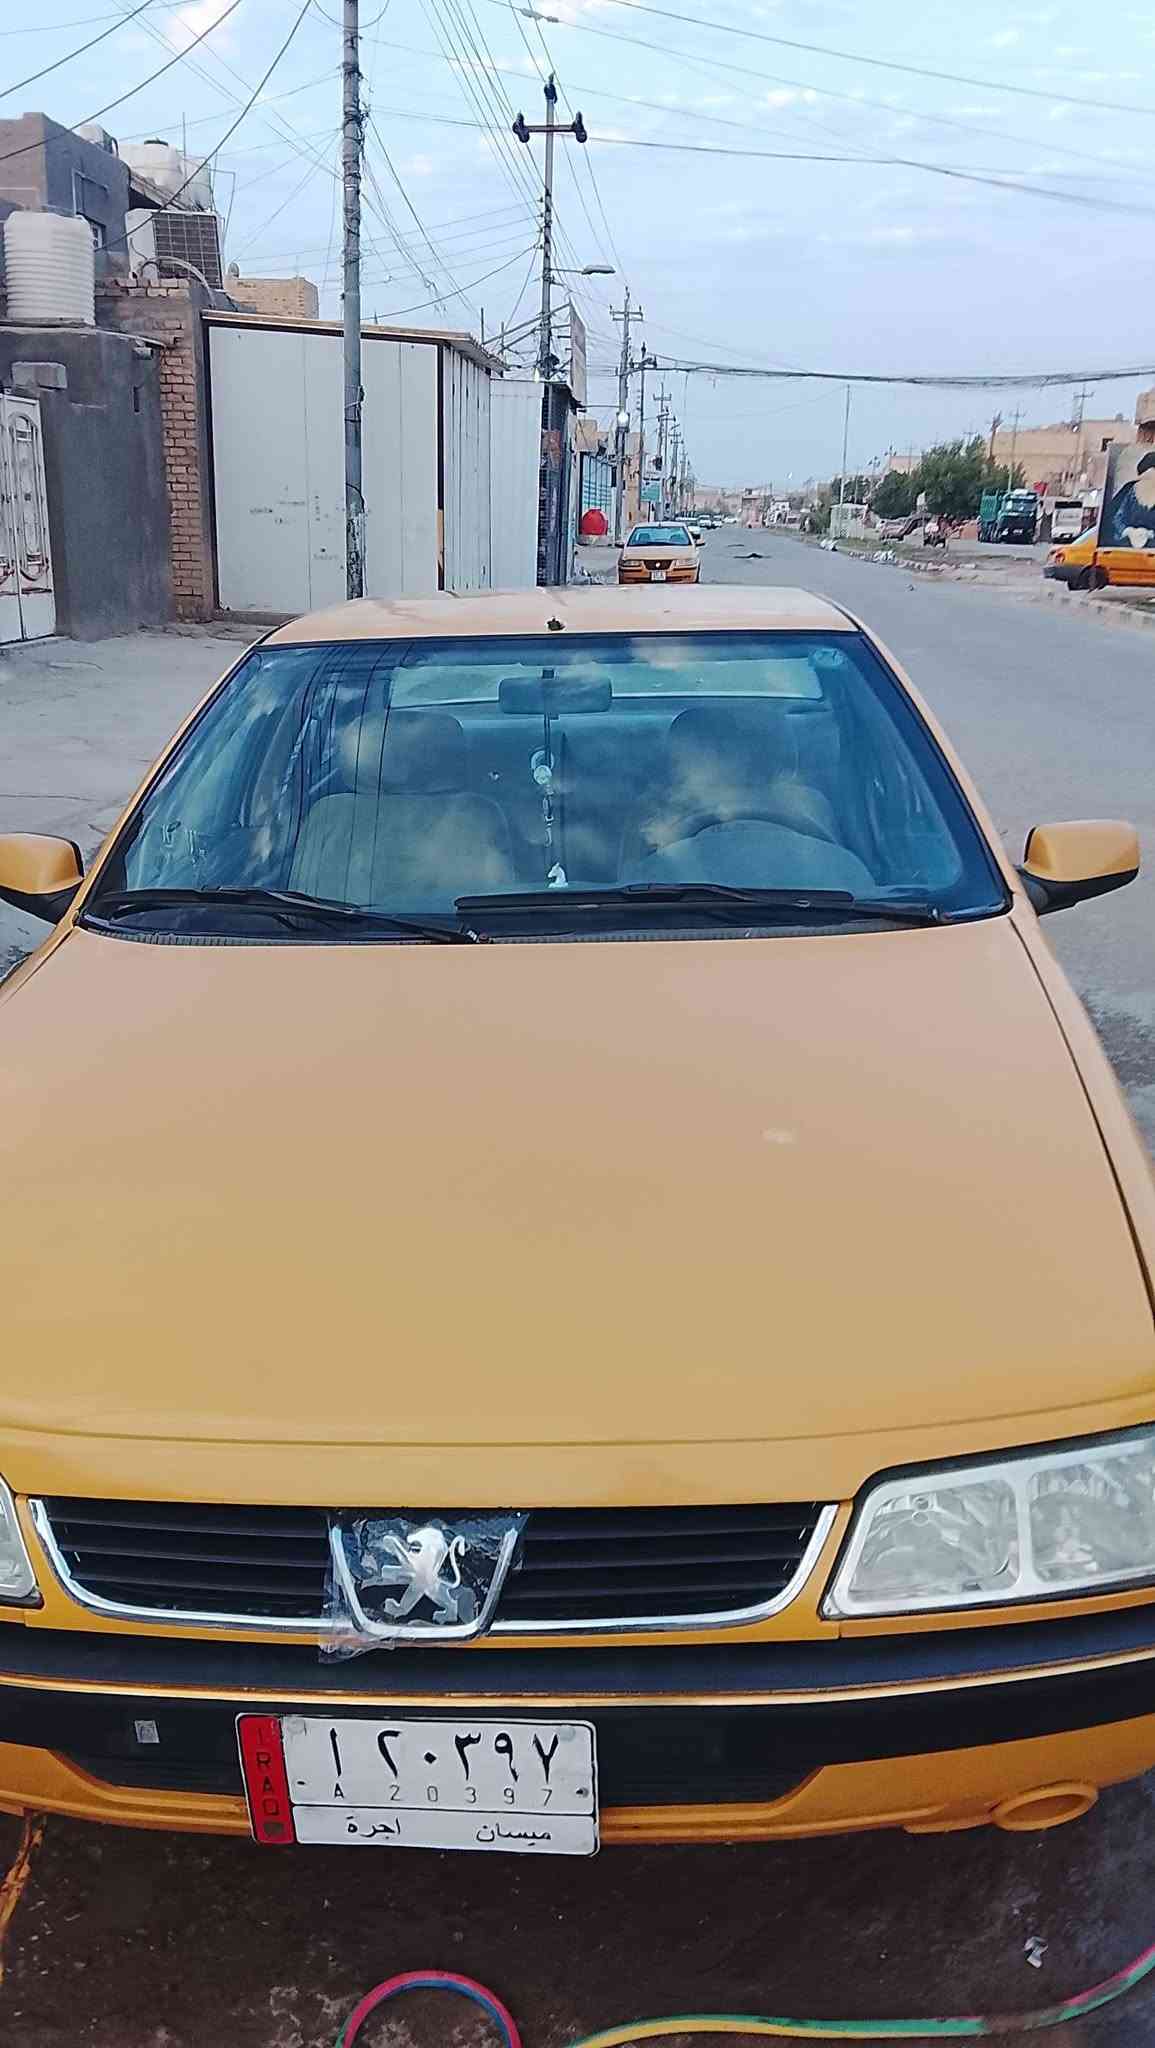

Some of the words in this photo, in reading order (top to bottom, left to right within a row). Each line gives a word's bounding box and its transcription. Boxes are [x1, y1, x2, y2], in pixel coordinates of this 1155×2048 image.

[334, 1782, 344, 1799] A
[390, 1784, 553, 1806] 20397
[346, 1815, 401, 1840] اجرة
[476, 1822, 552, 1846] ميسان
